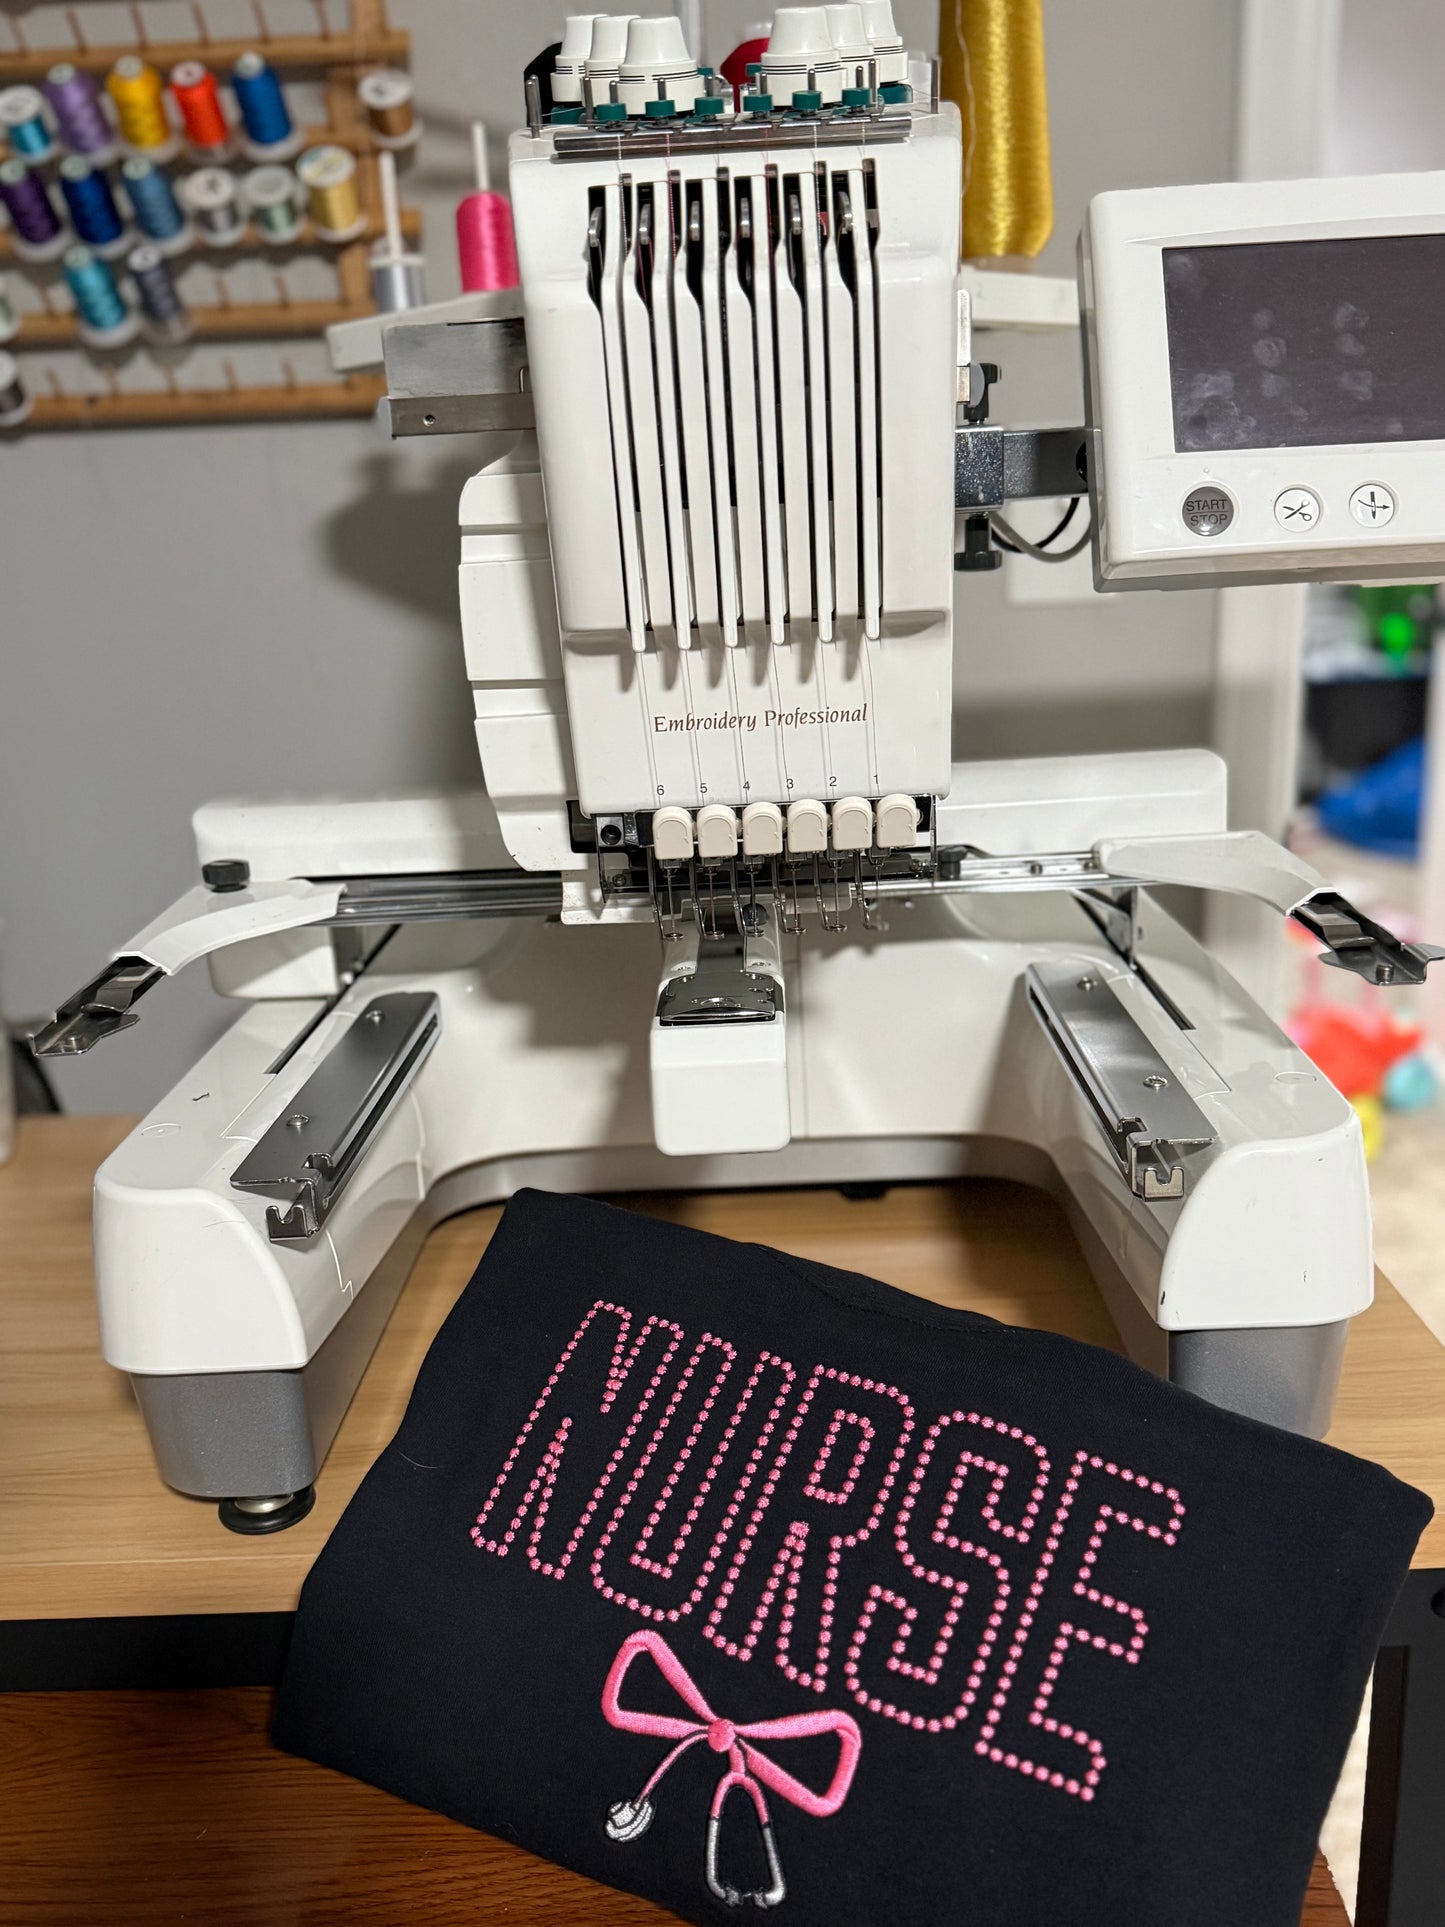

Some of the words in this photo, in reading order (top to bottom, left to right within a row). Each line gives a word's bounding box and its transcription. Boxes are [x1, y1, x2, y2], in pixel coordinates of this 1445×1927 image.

[1186, 499, 1226, 512] START
[1190, 513, 1228, 526] STOP
[654, 711, 757, 733] Embroidery
[765, 703, 868, 728] Professional
[656, 784, 665, 796] 6
[699, 782, 708, 794] 5
[742, 780, 751, 792] 4
[786, 778, 794, 790] 3
[829, 776, 837, 787] 2
[470, 1300, 1187, 1801] NURSE
